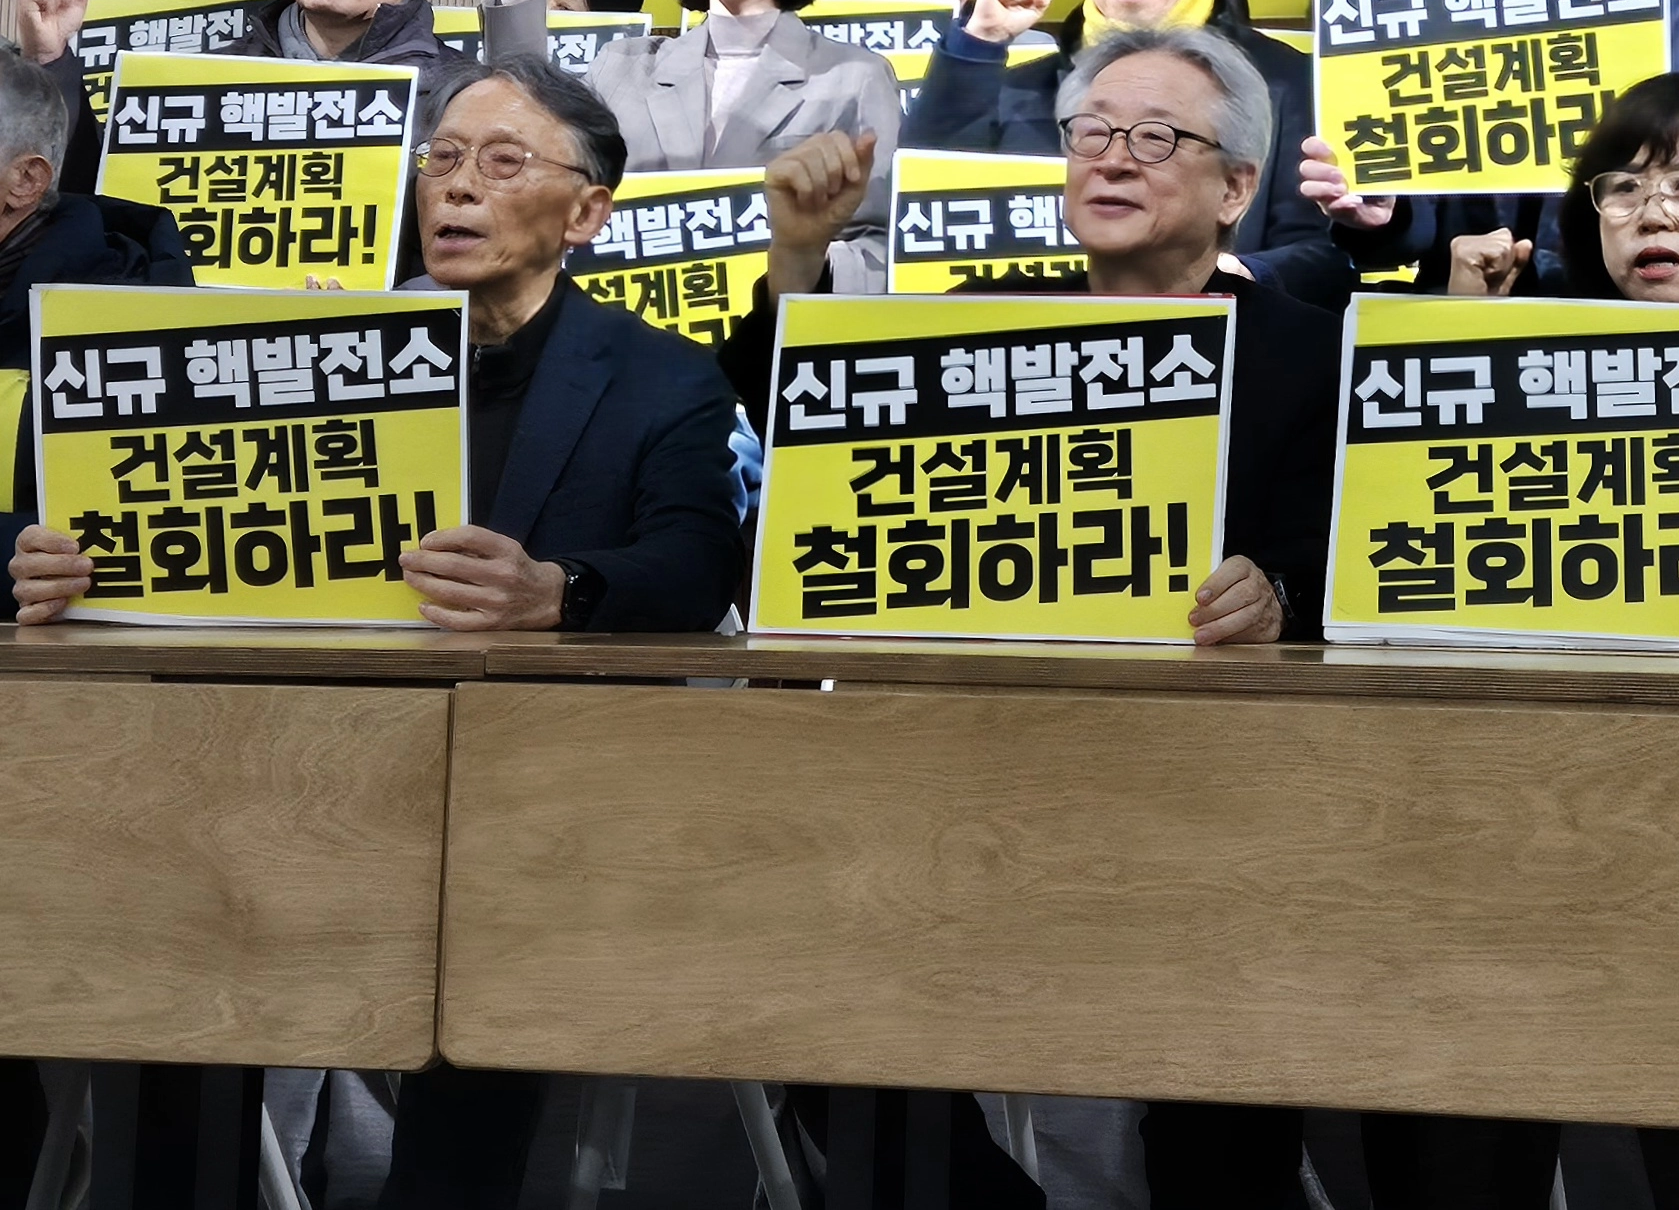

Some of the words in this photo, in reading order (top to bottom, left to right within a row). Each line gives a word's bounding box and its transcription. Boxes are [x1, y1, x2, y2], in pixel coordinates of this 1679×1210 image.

[68, 25, 118, 68] 규
[129, 8, 251, 53] 핵발전
[1381, 32, 1601, 108] 건설계획
[115, 94, 206, 145] 신규
[221, 89, 403, 142] 핵발전소
[1343, 89, 1618, 185] 철회하라
[156, 151, 344, 204] 건설계획
[178, 204, 377, 269] 회하라!
[897, 198, 994, 253] 신규
[43, 343, 167, 419] 신규
[184, 326, 456, 408] 핵발전소
[780, 355, 918, 431] 신규
[939, 333, 1217, 418] 핵발전소
[1354, 356, 1495, 429] 신규
[109, 418, 380, 504] 건설계획
[848, 427, 1134, 519] 건설계획
[793, 502, 1190, 620] 철회하라!
